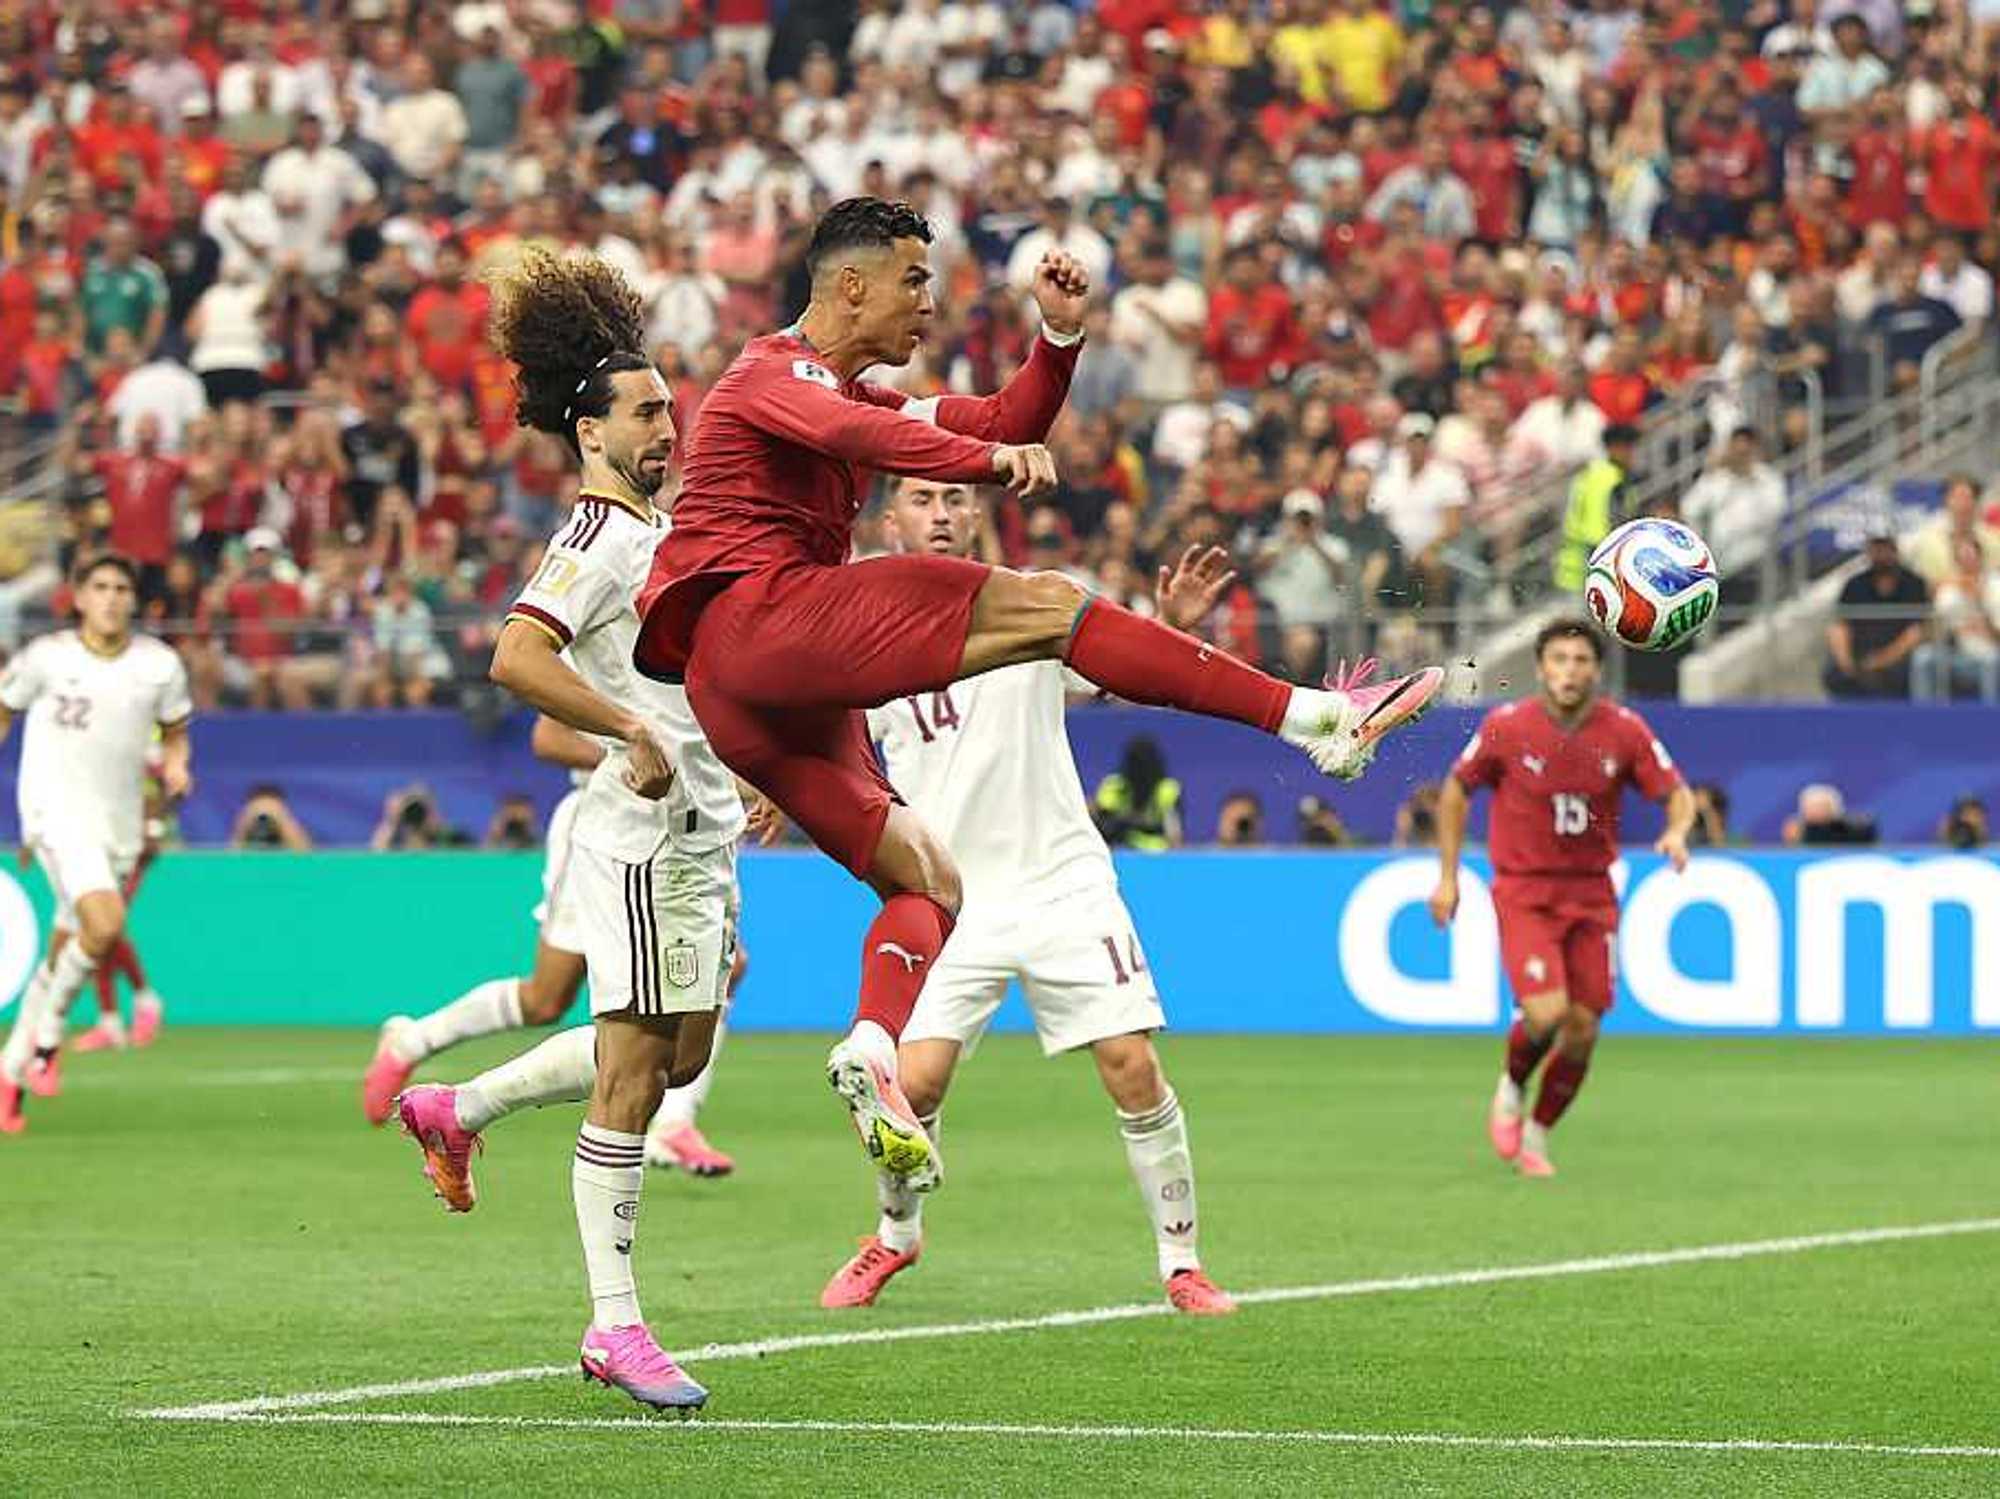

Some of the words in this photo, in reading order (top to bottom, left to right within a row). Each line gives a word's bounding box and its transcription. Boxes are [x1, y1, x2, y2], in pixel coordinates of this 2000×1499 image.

[55, 695, 92, 730] 22
[907, 691, 960, 742] 14
[1552, 793, 1590, 835] 15
[1338, 857, 2000, 1027] aam
